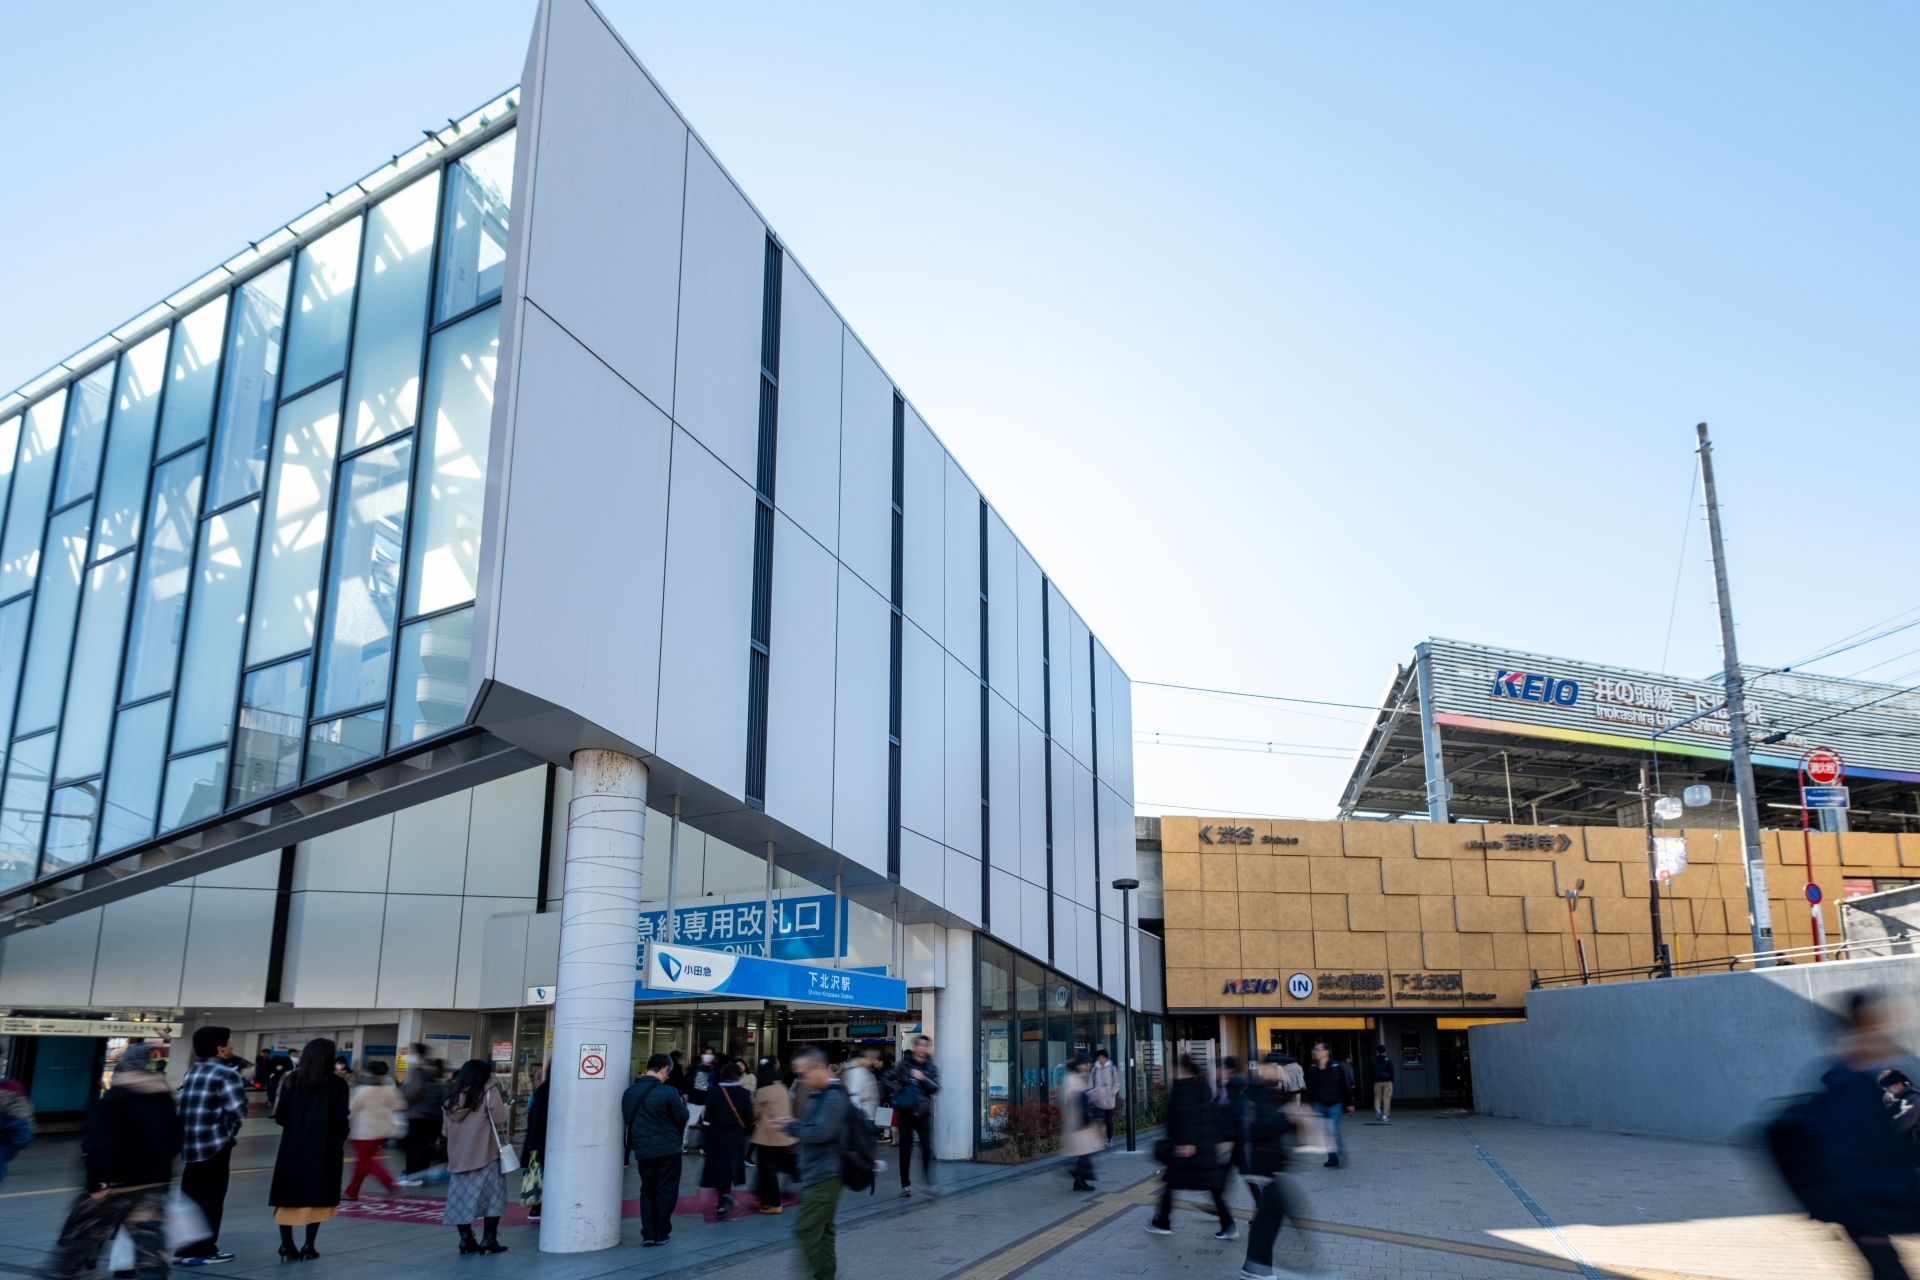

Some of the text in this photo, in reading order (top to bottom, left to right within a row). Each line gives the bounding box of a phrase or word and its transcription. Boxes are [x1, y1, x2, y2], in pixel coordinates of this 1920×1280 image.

[1492, 669, 1579, 707] KEIO
[1594, 678, 1761, 725] 井の頭線 下北駅
[1596, 705, 1655, 724] Inokashira
[1218, 825, 1254, 845] 渋谷
[1503, 833, 1555, 852] 吉祥寺
[684, 964, 712, 977] 小田急
[808, 971, 851, 991] 下北沢駅
[1223, 978, 1279, 995] KEIO
[1293, 981, 1308, 992] IN
[1318, 973, 1462, 991] 井の頭線 下北沢駅
